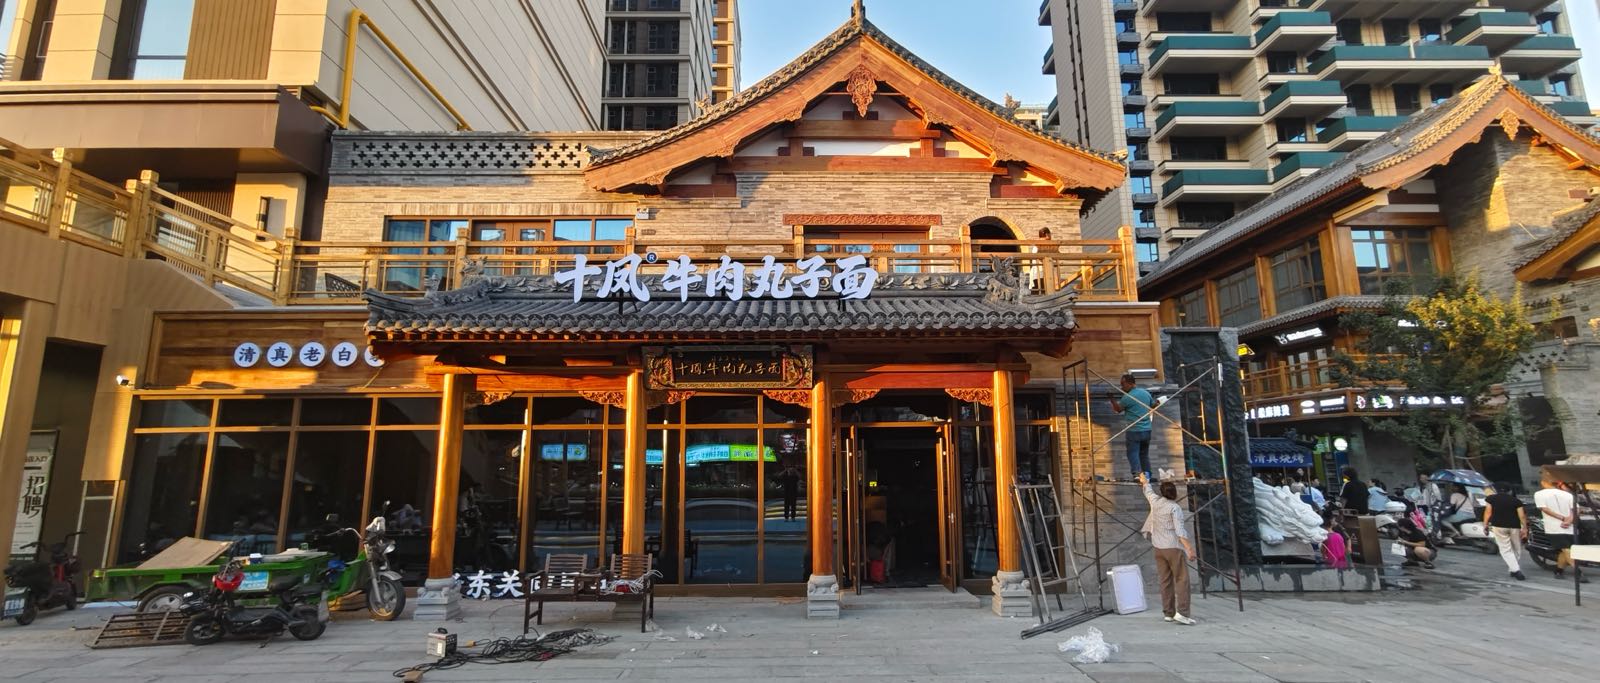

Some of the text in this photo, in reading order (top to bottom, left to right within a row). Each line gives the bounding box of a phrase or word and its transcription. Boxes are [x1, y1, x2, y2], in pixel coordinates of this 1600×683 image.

[237, 345, 381, 364] 清真老白
[1250, 452, 1304, 464] 清真烧烤
[23, 475, 46, 518] 招聘
